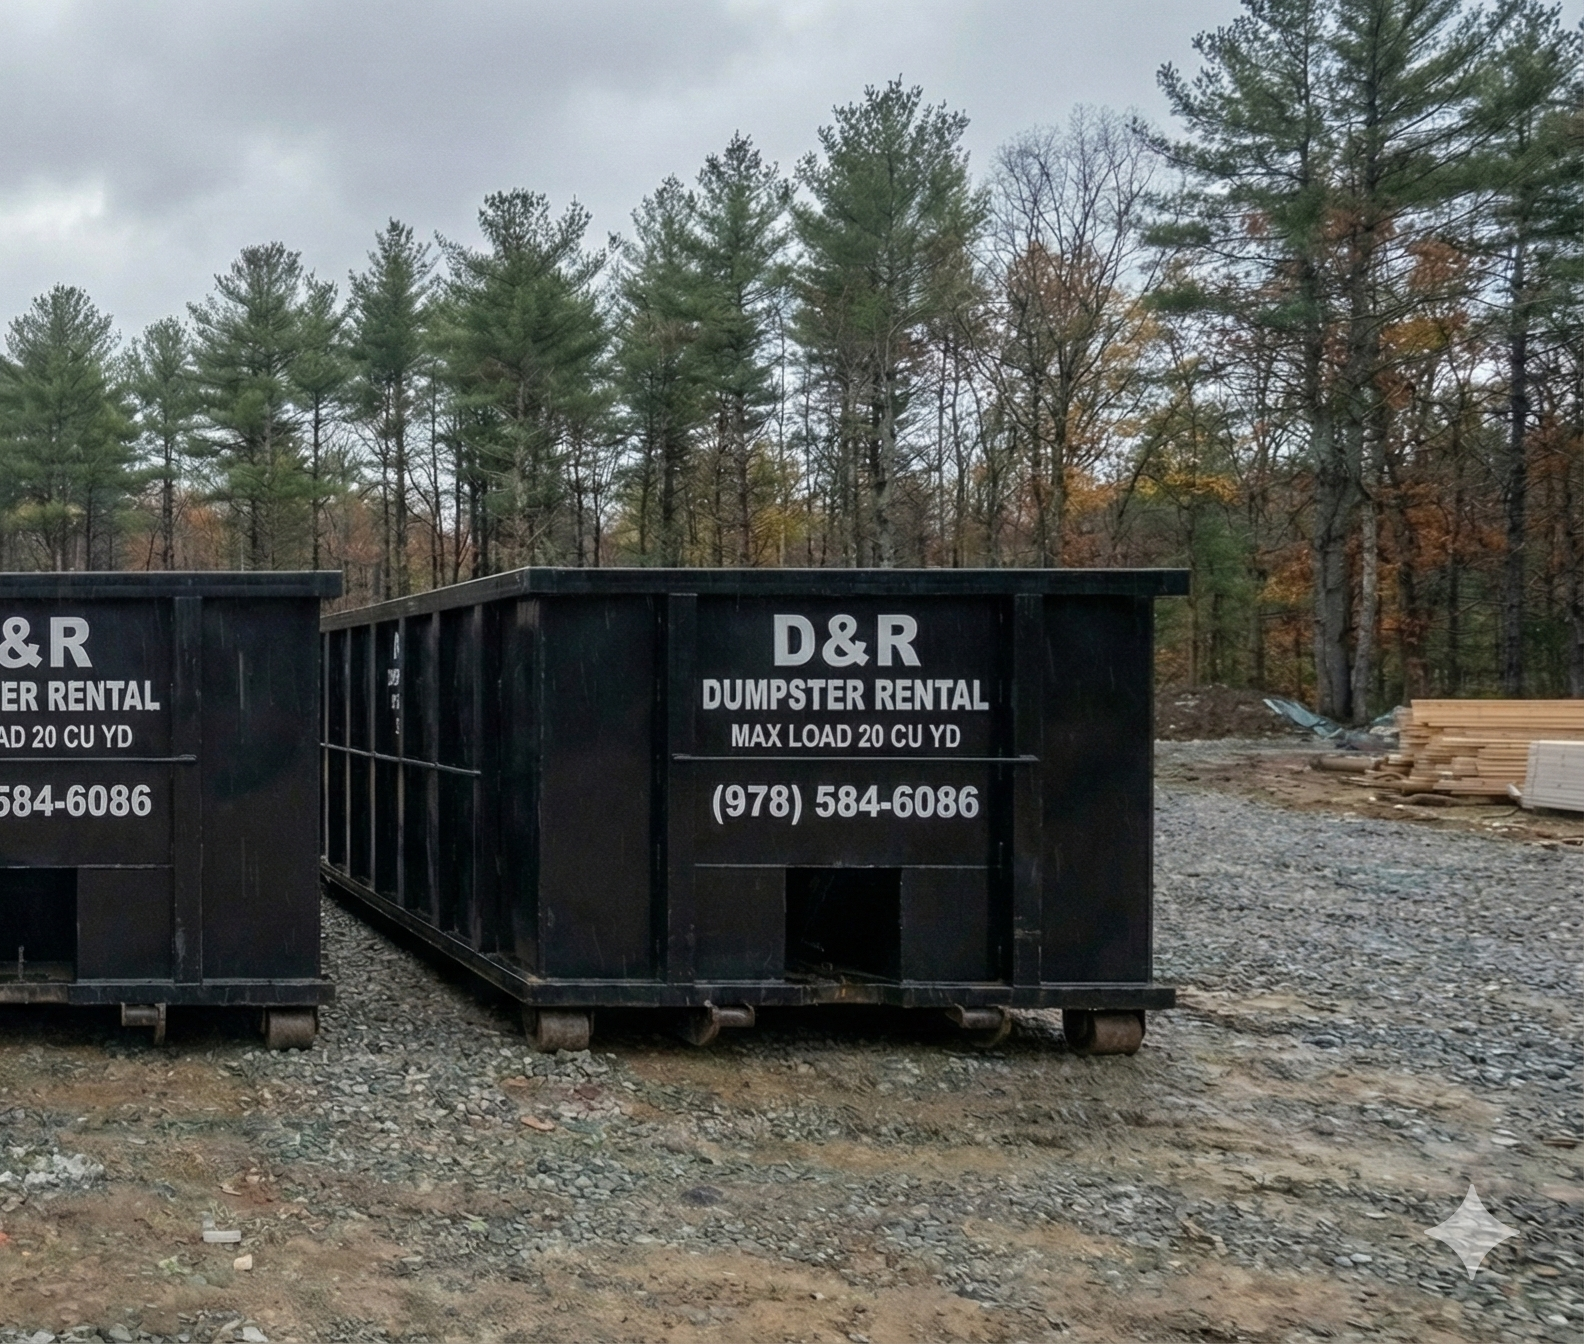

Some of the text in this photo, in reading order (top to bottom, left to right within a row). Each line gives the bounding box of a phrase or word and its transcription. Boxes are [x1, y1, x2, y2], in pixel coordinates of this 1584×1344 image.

[773, 613, 921, 667] D&R
[48, 680, 160, 711] RENTAL
[702, 679, 989, 711] DUMPSTER RENTAL
[32, 725, 57, 748] 20
[64, 725, 95, 748] CU
[101, 725, 133, 748] YD
[731, 724, 961, 748] MAX LOAD 20 CU YD
[712, 784, 980, 825] (978) 584-6086
